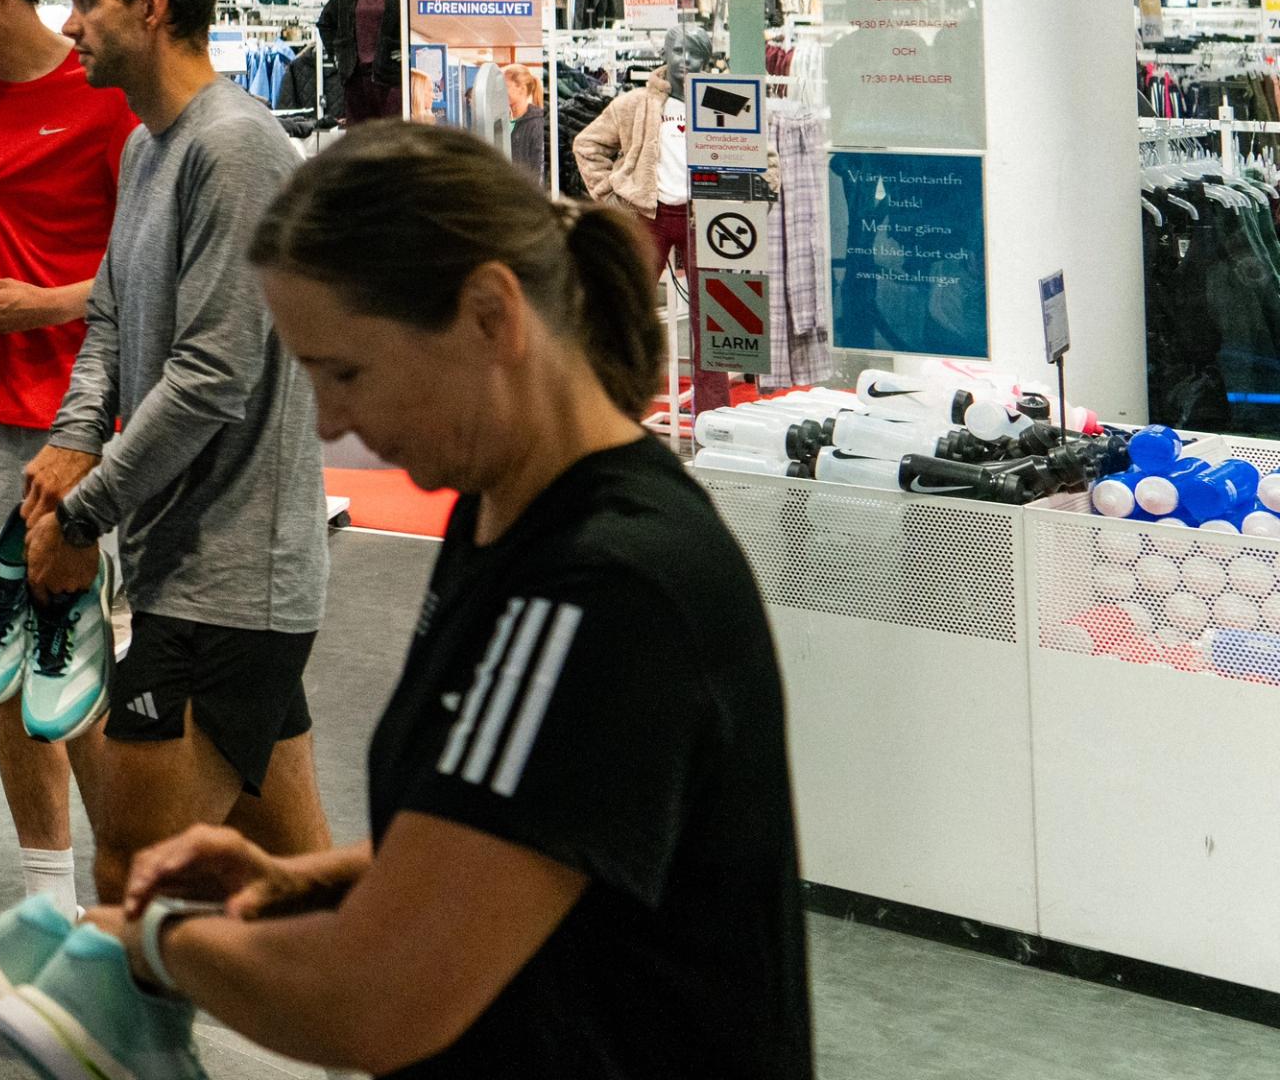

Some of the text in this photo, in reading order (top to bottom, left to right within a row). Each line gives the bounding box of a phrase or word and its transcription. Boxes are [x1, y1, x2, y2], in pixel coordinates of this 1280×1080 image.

[427, 0, 530, 13] FÖRENINGSLIVET
[892, 48, 916, 56] OCH
[861, 75, 887, 83] 17:30
[907, 75, 952, 83] HELGER
[848, 170, 862, 183] Vi
[862, 219, 952, 237] Men tar gärna
[915, 245, 941, 258] kort
[944, 247, 968, 259] och
[712, 335, 759, 351] LARM
